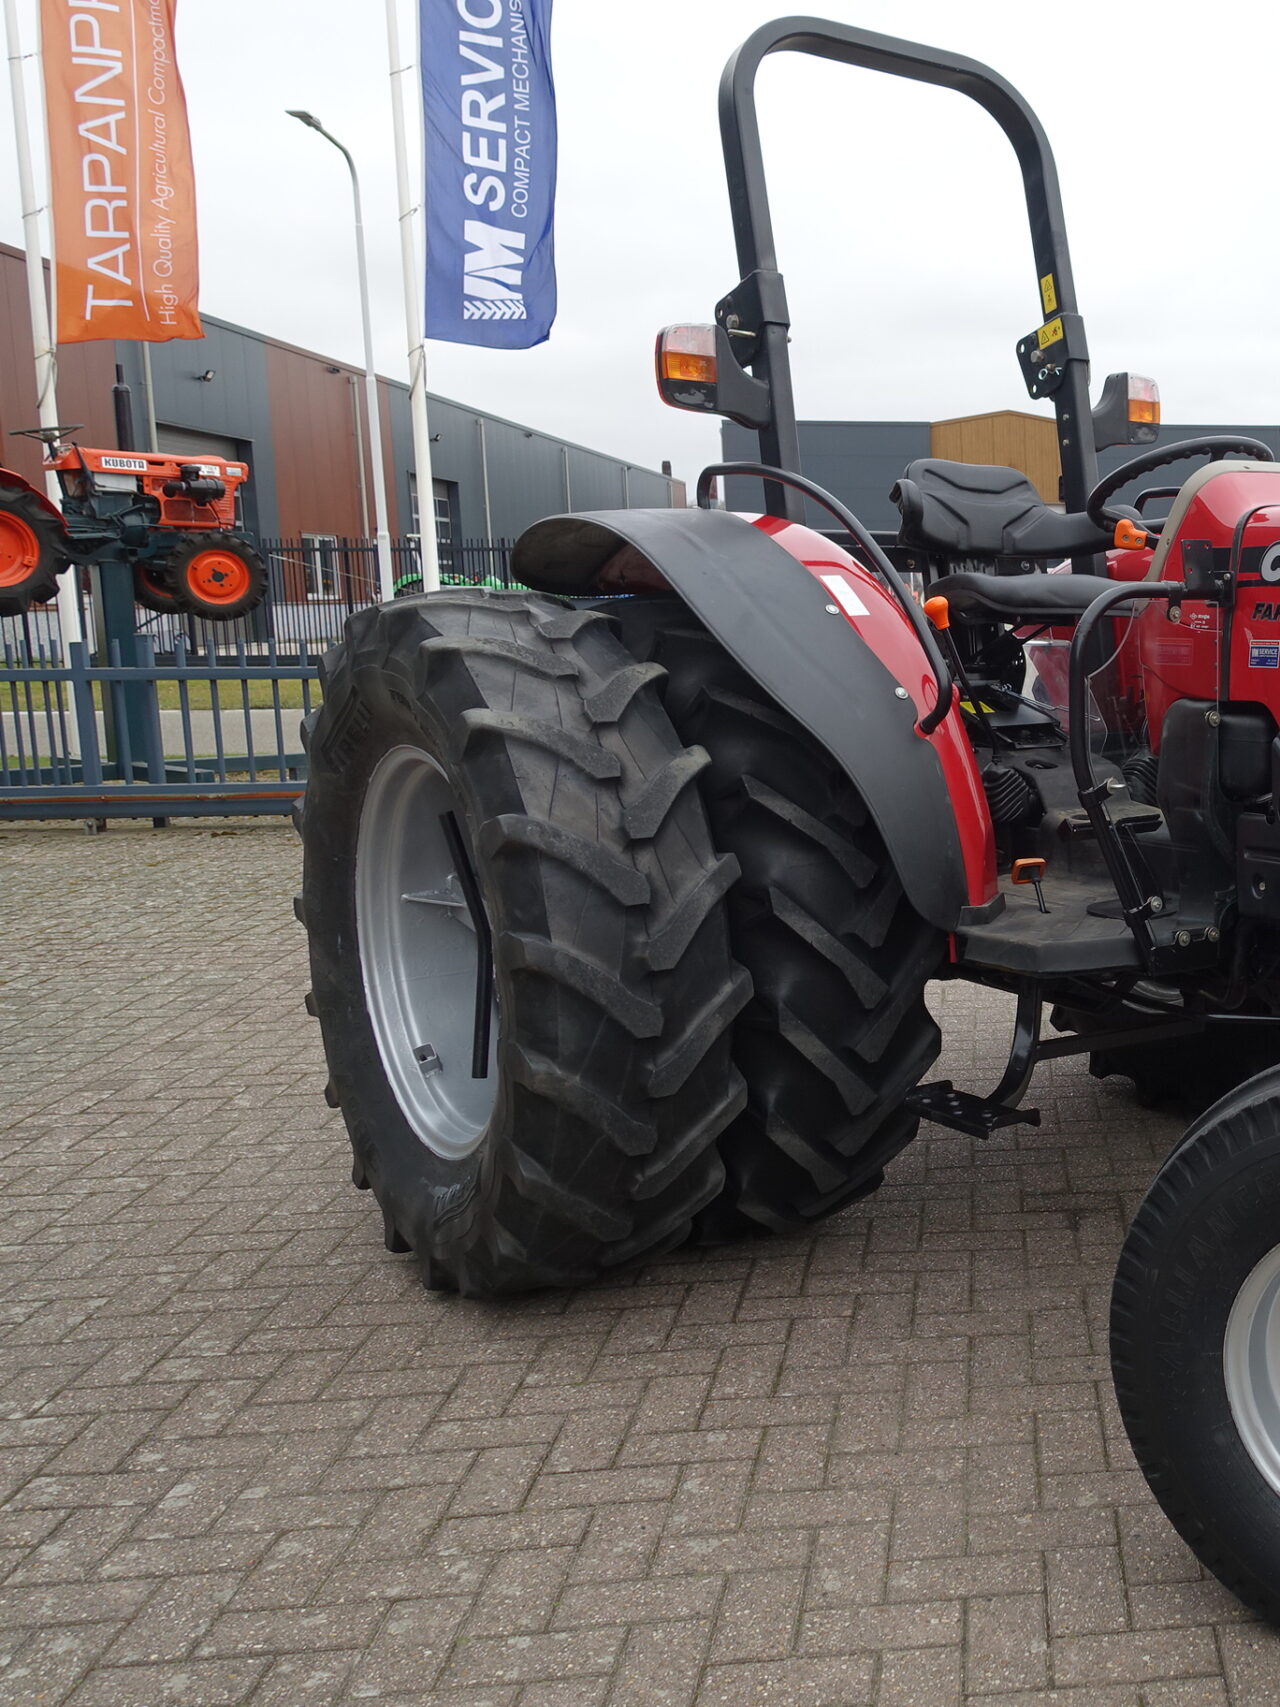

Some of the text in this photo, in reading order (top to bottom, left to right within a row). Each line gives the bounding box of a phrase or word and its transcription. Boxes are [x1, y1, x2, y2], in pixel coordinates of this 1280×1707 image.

[509, 0, 531, 218] COMPACT MECHANIS
[148, 108, 174, 211] Agricultural
[151, 215, 176, 278] Quality
[154, 284, 179, 325] High
[103, 457, 145, 470] KUBOTA
